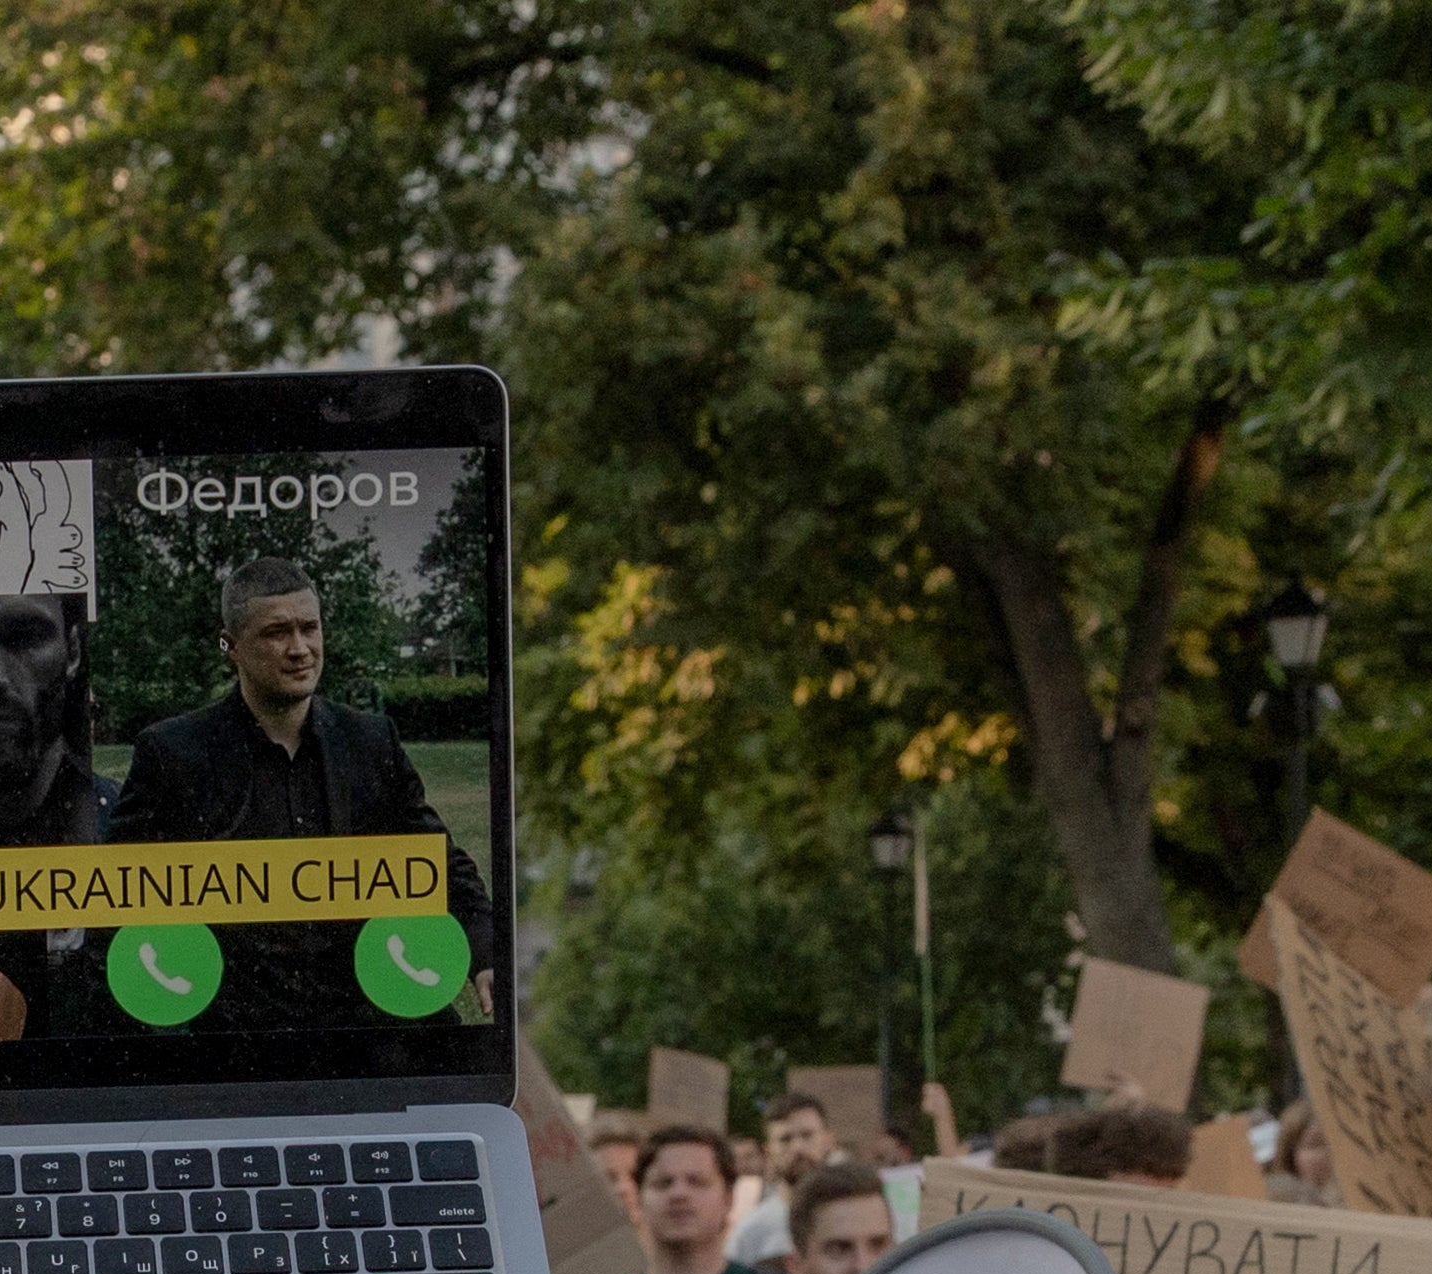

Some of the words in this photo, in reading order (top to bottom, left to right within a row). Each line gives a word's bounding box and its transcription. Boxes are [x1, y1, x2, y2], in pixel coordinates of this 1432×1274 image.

[133, 467, 423, 524] Федоров
[292, 857, 438, 902] CHAD
[439, 1208, 475, 1216] delete
[16, 1218, 26, 1229] 7
[83, 1216, 94, 1227] 8
[149, 1214, 160, 1225] 9
[254, 1248, 264, 1258] P
[51, 1255, 63, 1265] U
[137, 1263, 151, 1272] Ш
